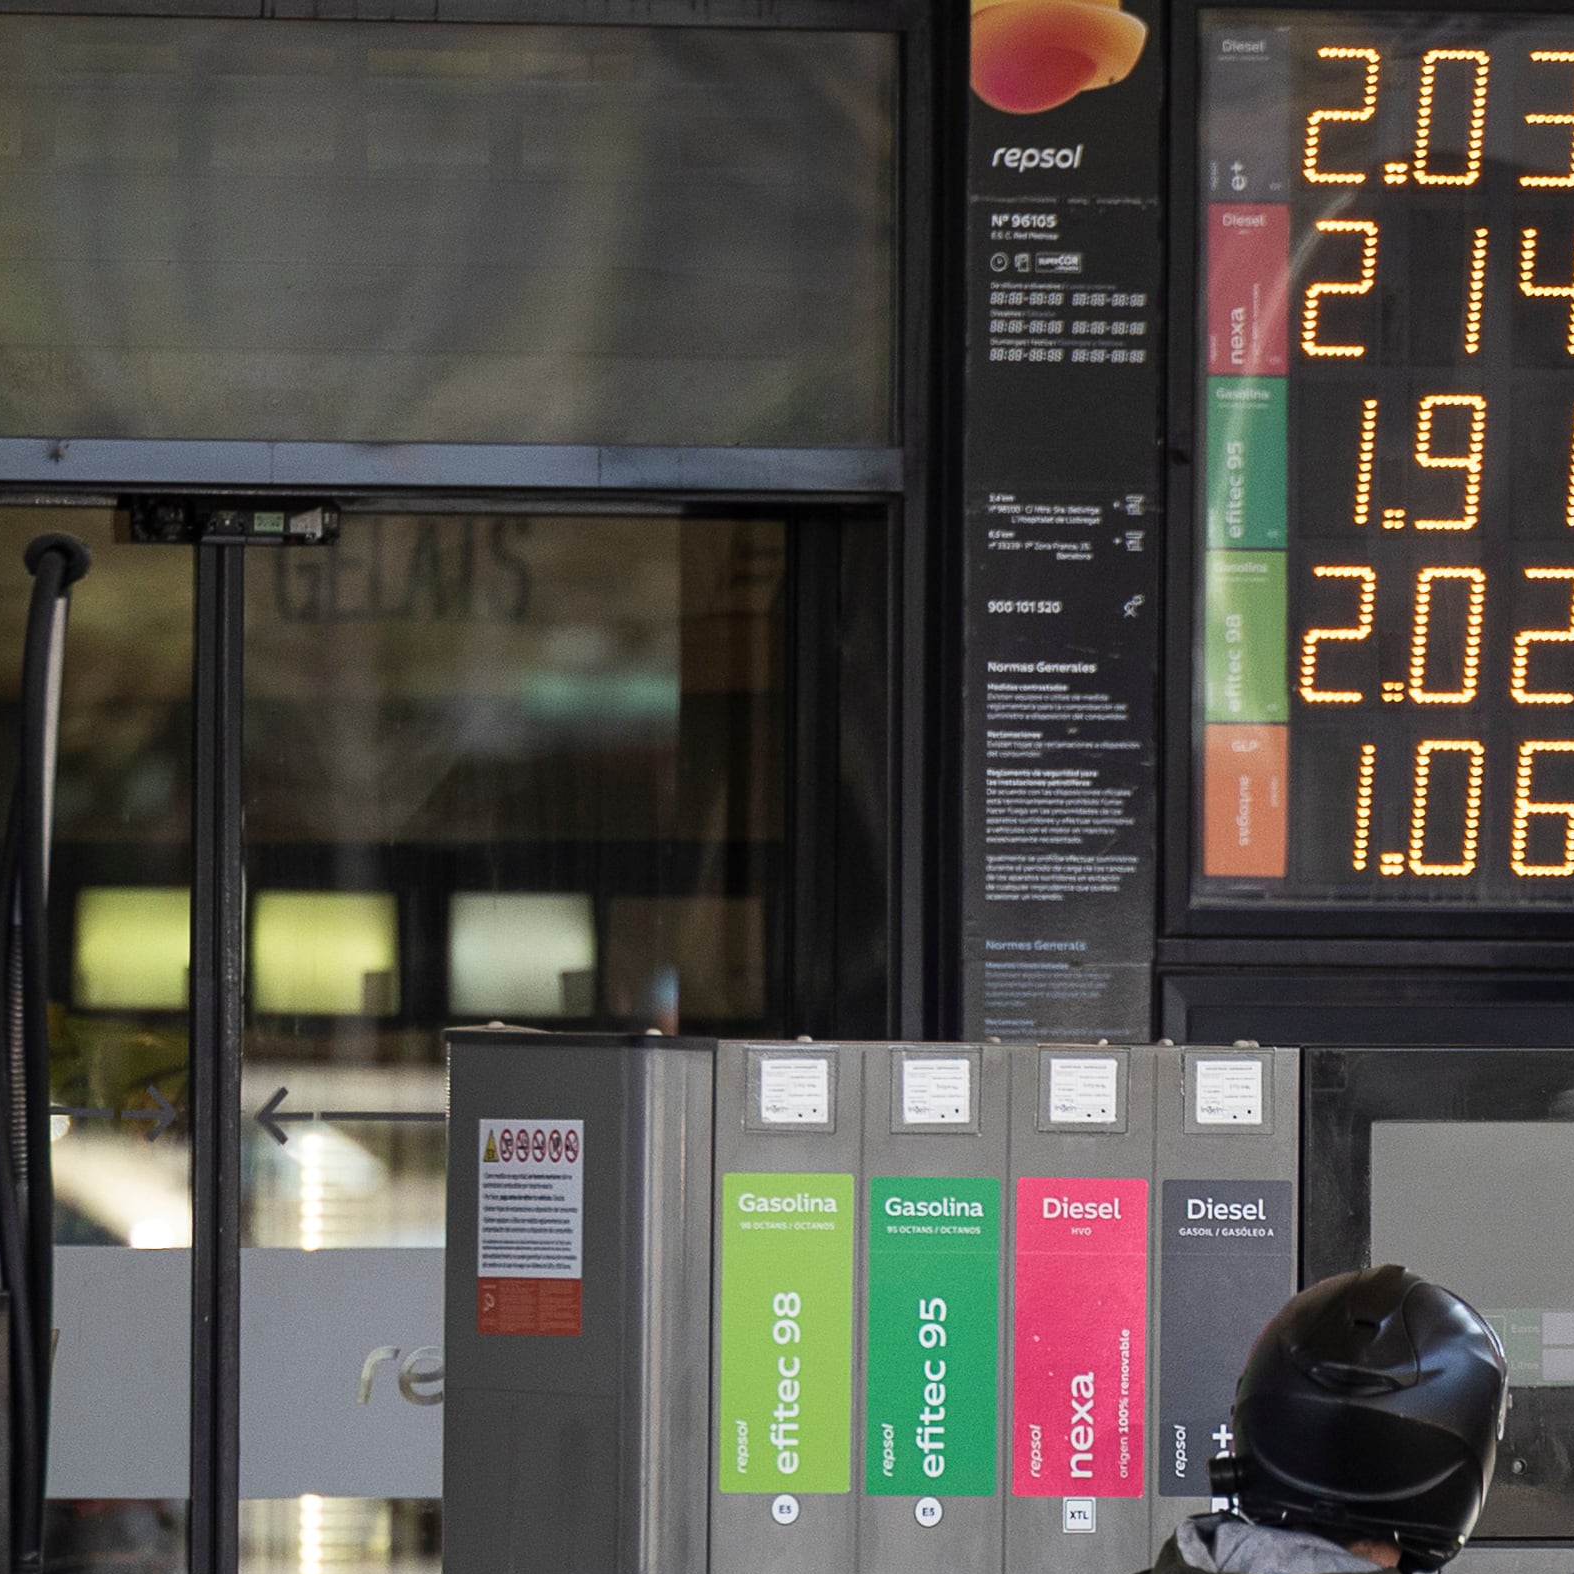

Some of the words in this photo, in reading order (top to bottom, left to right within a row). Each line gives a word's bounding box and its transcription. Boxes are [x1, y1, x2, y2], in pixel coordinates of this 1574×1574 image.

[1222, 39, 1265, 52] Diesel
[992, 143, 1083, 172] repsol
[1011, 214, 1057, 228] 96105
[1222, 214, 1265, 226] Diesel
[1231, 307, 1245, 364] nexa
[988, 601, 1013, 613] 900
[1016, 601, 1035, 613] 101
[1037, 601, 1061, 613] 520
[988, 661, 1034, 674] Normas
[1036, 661, 1097, 674] Generales
[986, 940, 1031, 951] Normes
[1034, 940, 1086, 951] Generals
[738, 1193, 838, 1213] Gasolina
[884, 1197, 984, 1217] Gasolina
[1042, 1197, 1122, 1220] Diesel
[1187, 1198, 1266, 1221] Diesel
[900, 1226, 933, 1234] OCTANS
[940, 1226, 981, 1235] OCTANOS
[1071, 1227, 1092, 1236] HVO
[1179, 1227, 1213, 1237] GASOIL
[1222, 1225, 1265, 1237] GASÓLEO
[1267, 1228, 1274, 1237] A
[773, 1292, 801, 1345] 98
[919, 1298, 947, 1349] 95
[1119, 1329, 1130, 1395] renovable
[770, 1356, 800, 1474] efitec
[916, 1360, 946, 1478] efitec
[1070, 1371, 1094, 1479] nexa
[1119, 1396, 1130, 1433] 100%
[736, 1420, 749, 1474] repsol
[882, 1423, 895, 1477] repsol
[1029, 1424, 1043, 1478] repsol
[1119, 1437, 1131, 1479] origen
[1175, 1425, 1188, 1478] repsol
[779, 1505, 791, 1514] E5
[922, 1507, 935, 1517] E5
[1070, 1511, 1088, 1520] XTL
